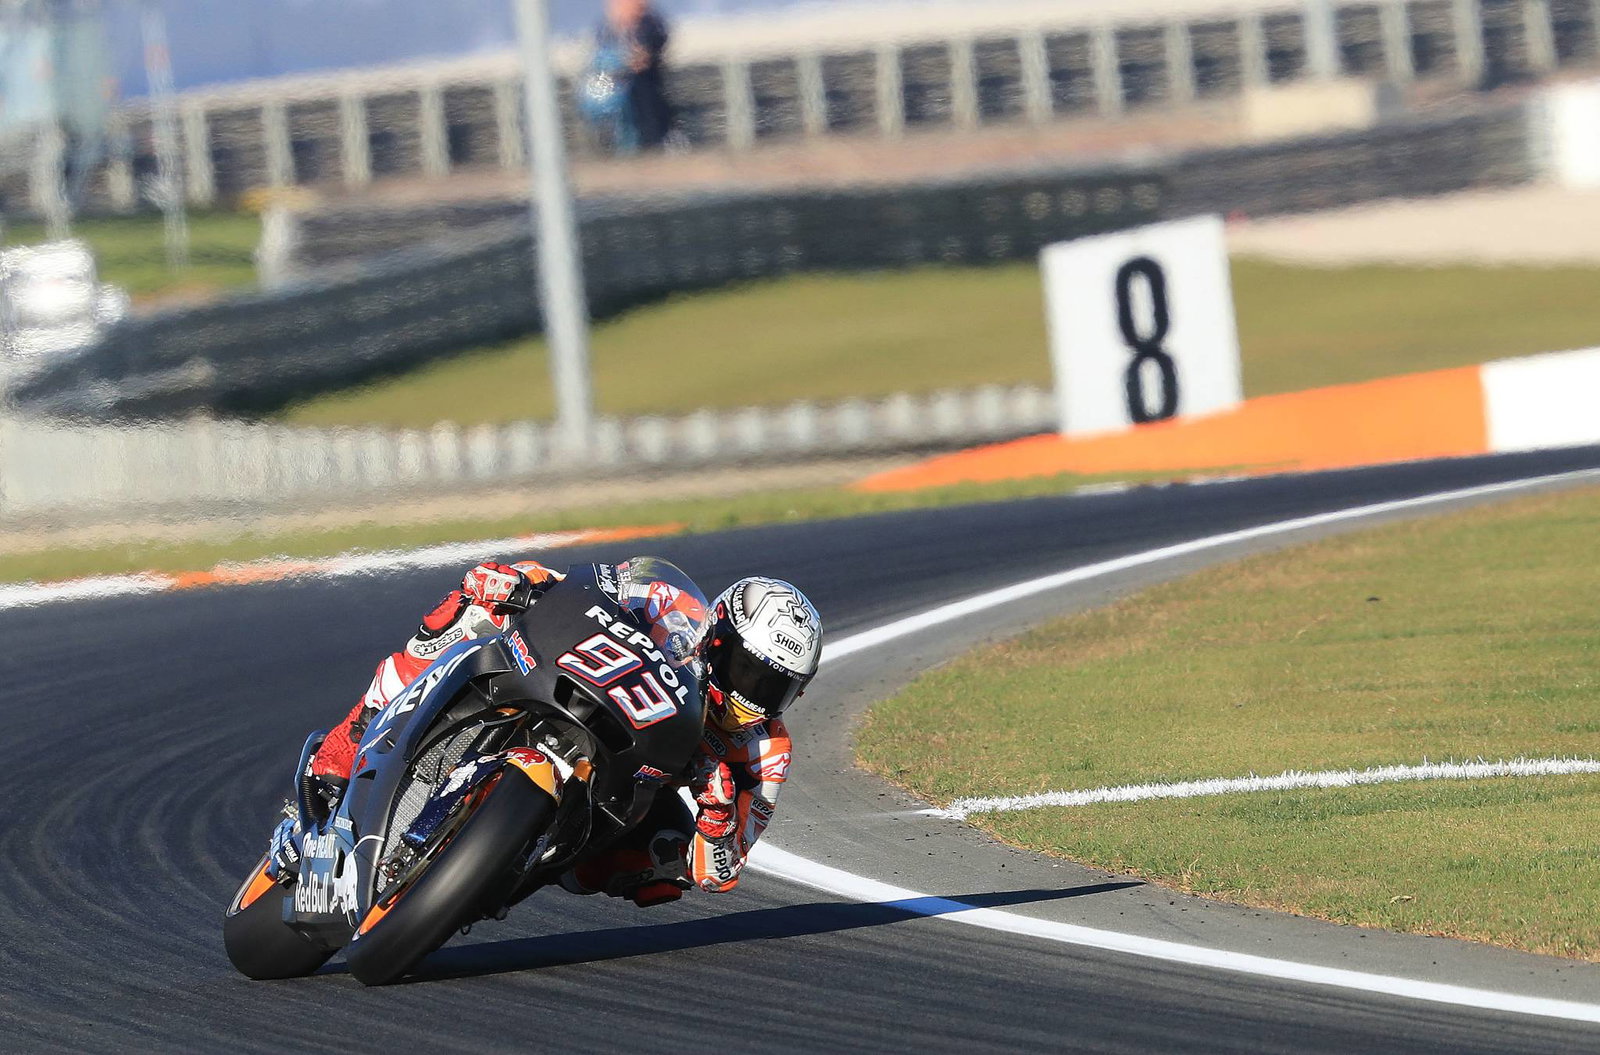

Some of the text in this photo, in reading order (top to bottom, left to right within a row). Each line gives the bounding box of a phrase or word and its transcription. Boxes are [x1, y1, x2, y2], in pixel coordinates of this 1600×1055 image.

[1116, 257, 1178, 424] 8
[413, 627, 464, 656] alpinestars
[585, 604, 689, 705] REPSOL
[774, 633, 802, 656] SHOEI
[557, 632, 678, 730] 93
[768, 660, 785, 673] YOU
[730, 690, 766, 714] PULL&BEAR
[752, 799, 775, 818] REPS
[295, 870, 330, 913] Red Bull
